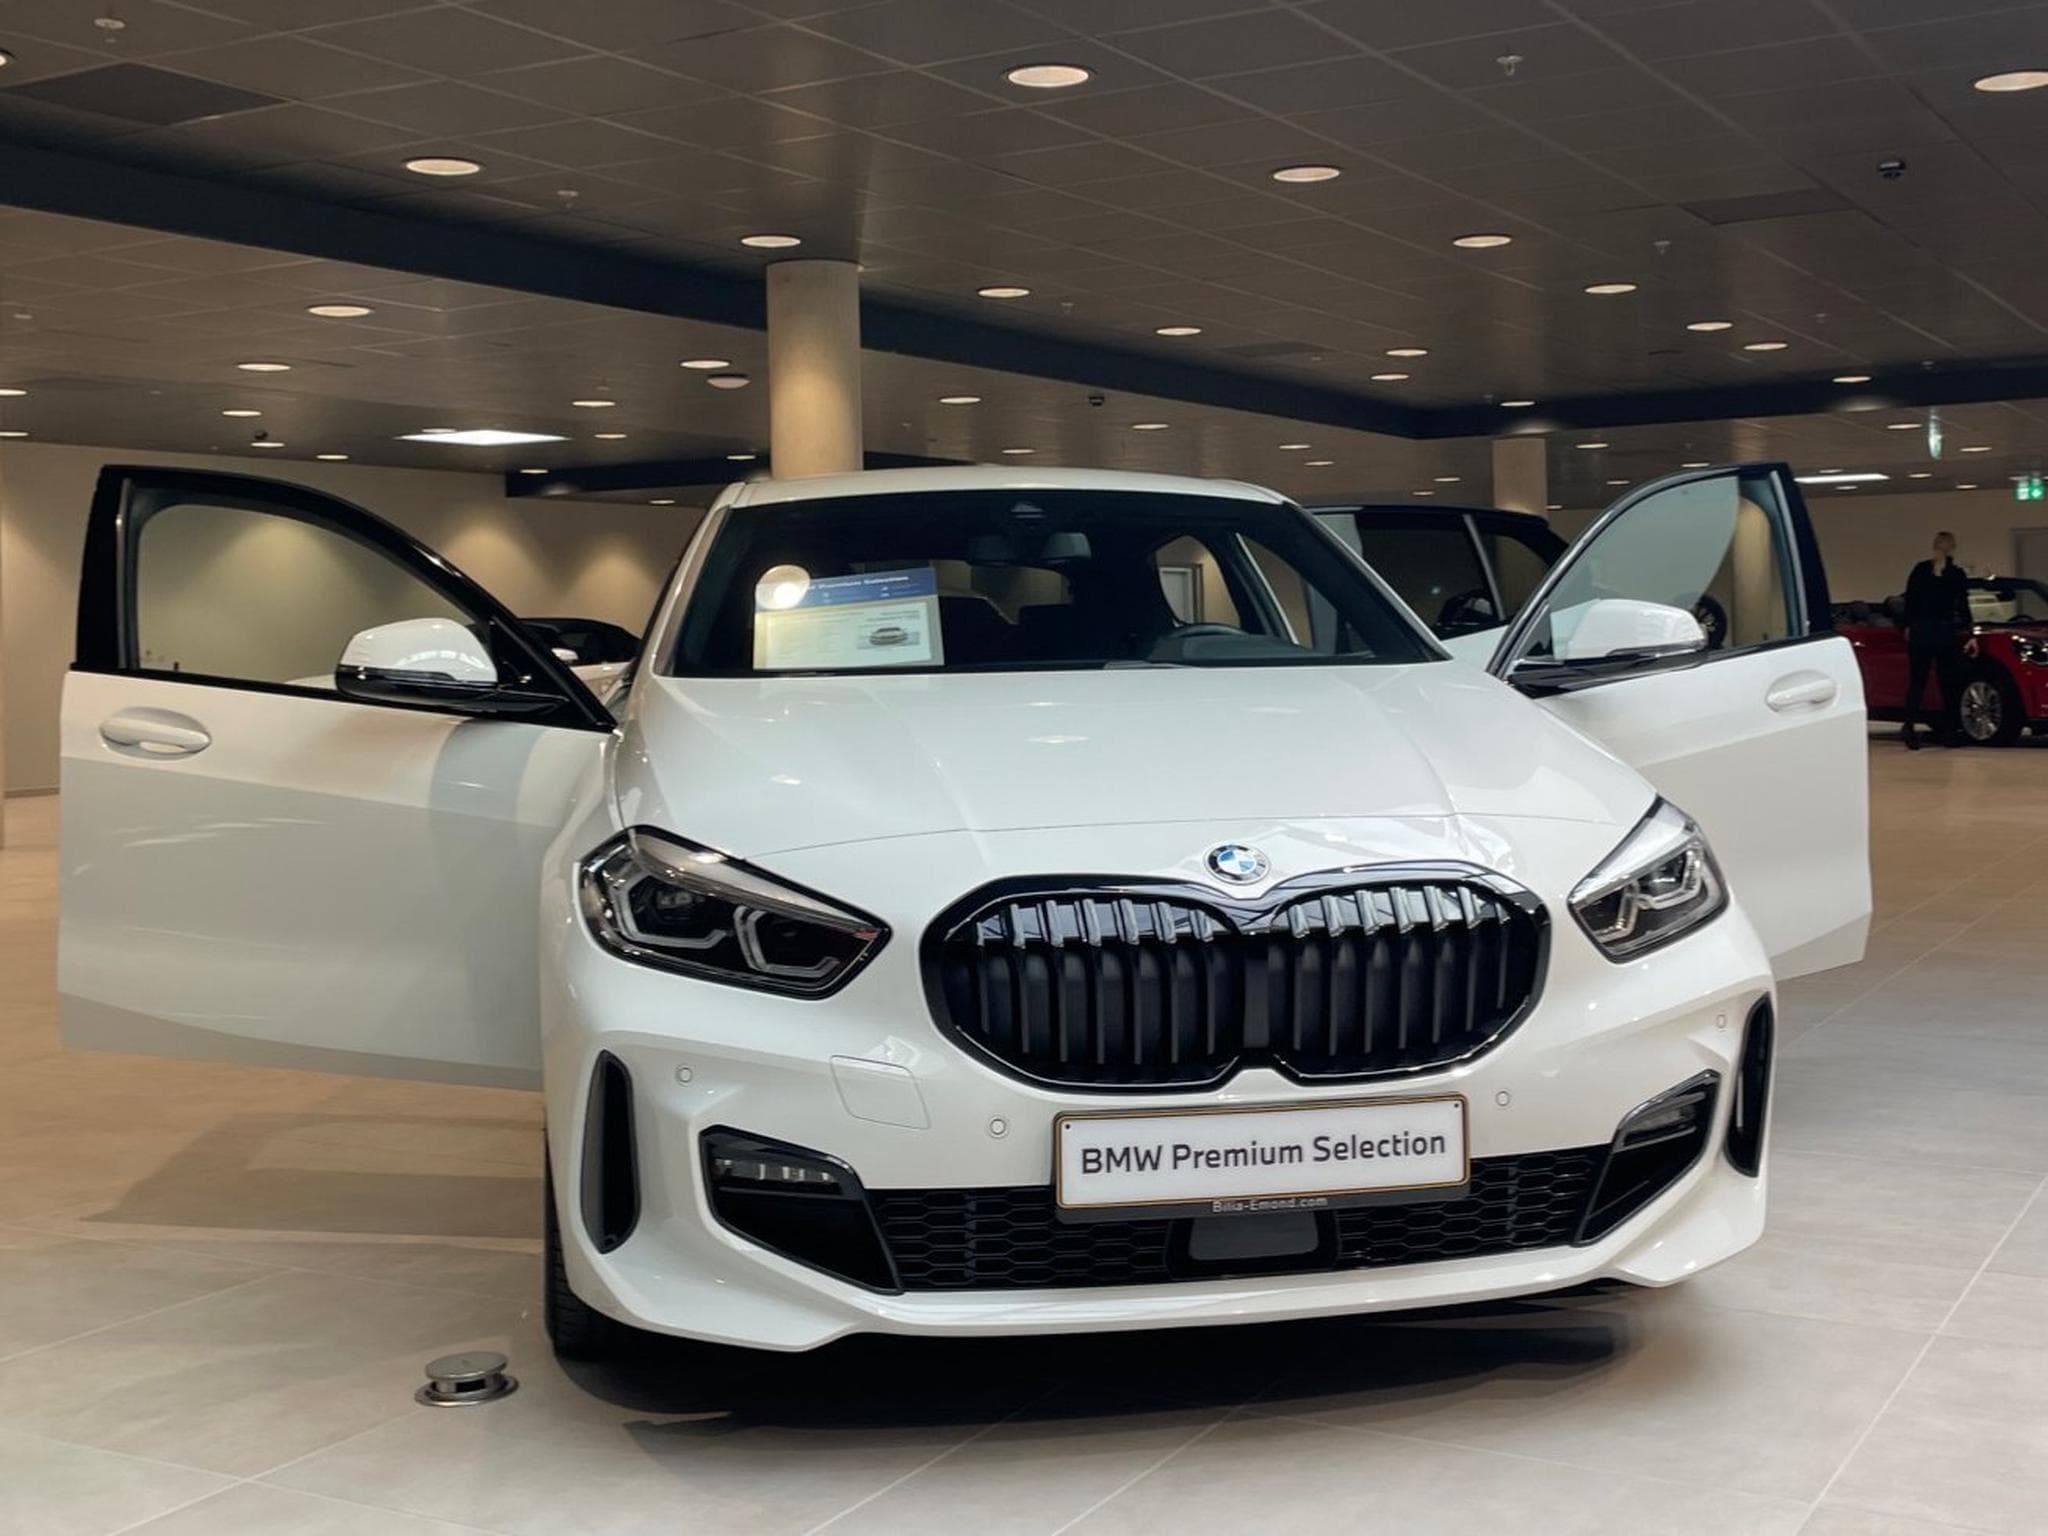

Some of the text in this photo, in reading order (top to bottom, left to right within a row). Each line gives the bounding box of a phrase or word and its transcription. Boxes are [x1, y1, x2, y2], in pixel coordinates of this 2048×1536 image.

[1081, 1131, 1446, 1174] BMW Premium Selection
[1212, 1197, 1328, 1213] Bilia-Emond.com
